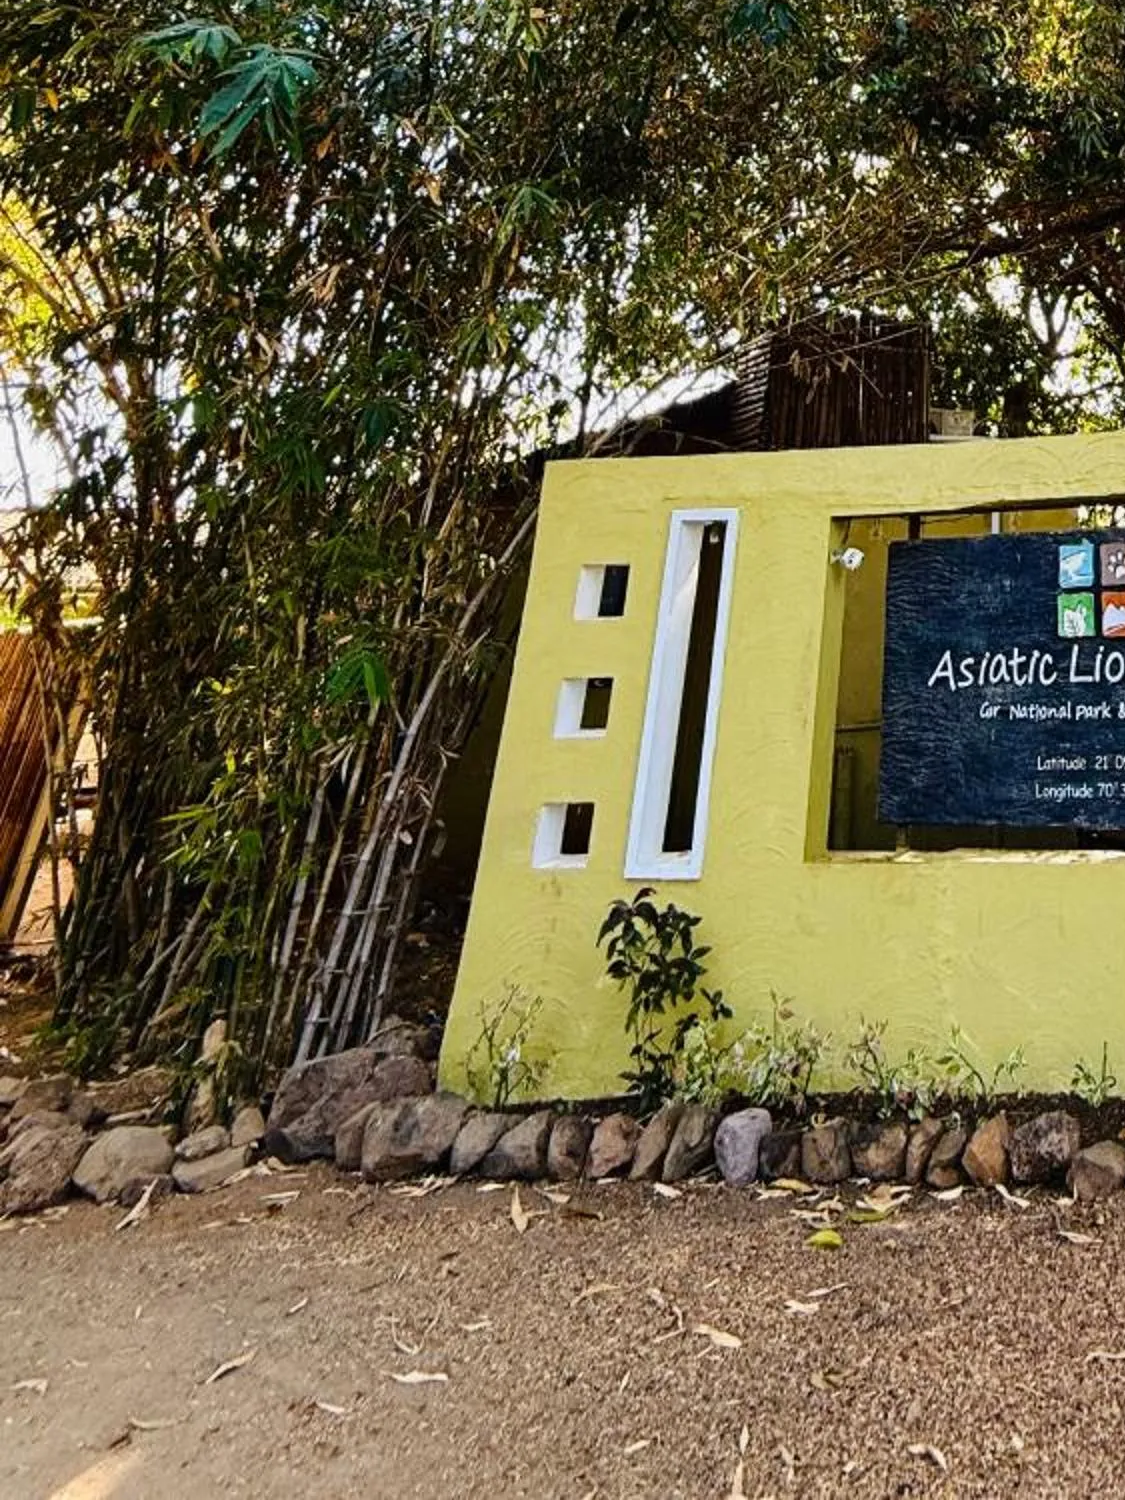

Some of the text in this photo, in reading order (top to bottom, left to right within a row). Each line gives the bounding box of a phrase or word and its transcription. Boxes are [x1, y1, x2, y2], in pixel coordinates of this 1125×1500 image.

[928, 649, 1057, 692] Asiatic
[1009, 700, 1072, 722] National
[1075, 701, 1112, 721] Park
[1036, 755, 1087, 771] Latitude
[1035, 781, 1094, 803] Longitude
